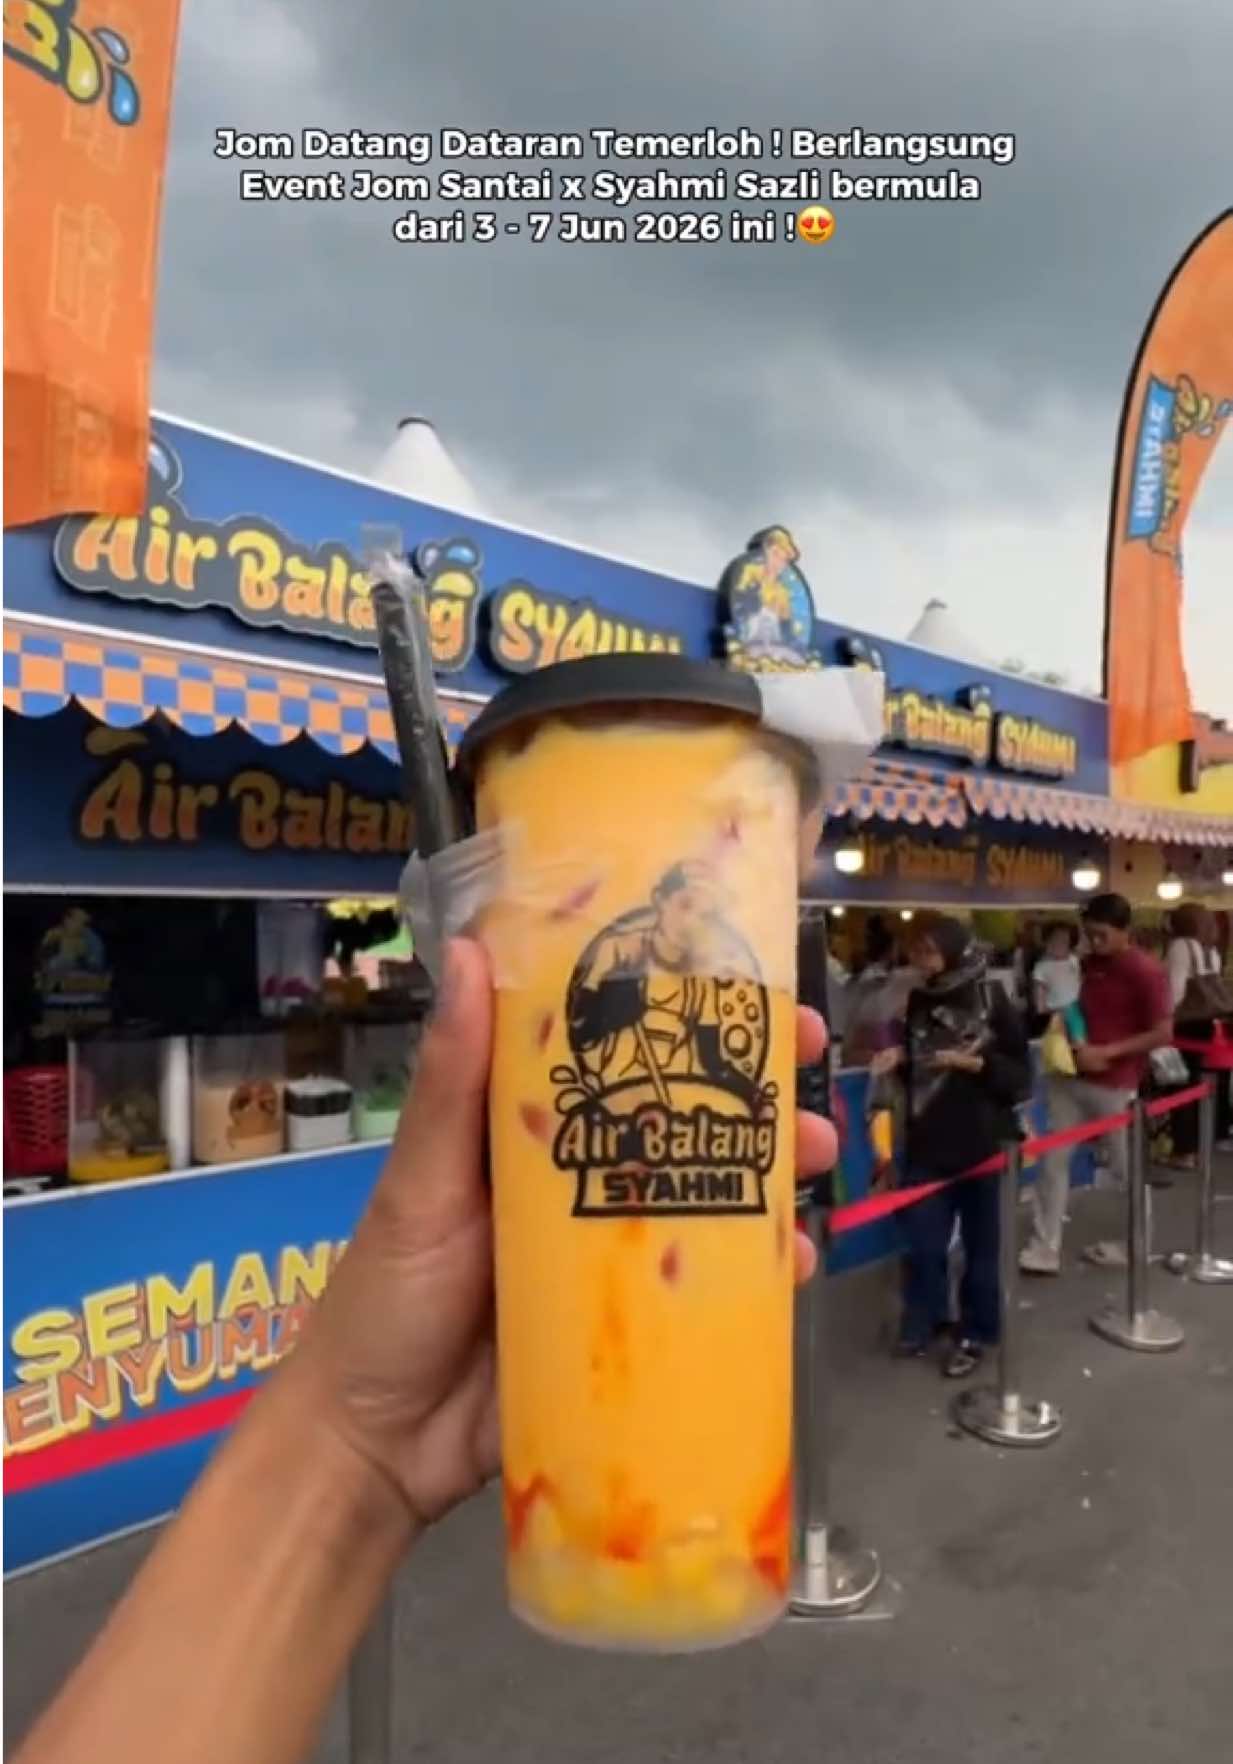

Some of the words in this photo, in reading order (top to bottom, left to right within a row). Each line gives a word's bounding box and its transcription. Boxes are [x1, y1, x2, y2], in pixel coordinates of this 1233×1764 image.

[73, 506, 218, 592] Air
[228, 531, 475, 661] Balag
[80, 758, 218, 841] Air
[228, 770, 415, 851] Balan
[557, 1110, 629, 1163] Air
[635, 1108, 775, 1168] Balang
[602, 1171, 745, 1204] SYAHMI
[11, 1239, 350, 1383] SEMAN
